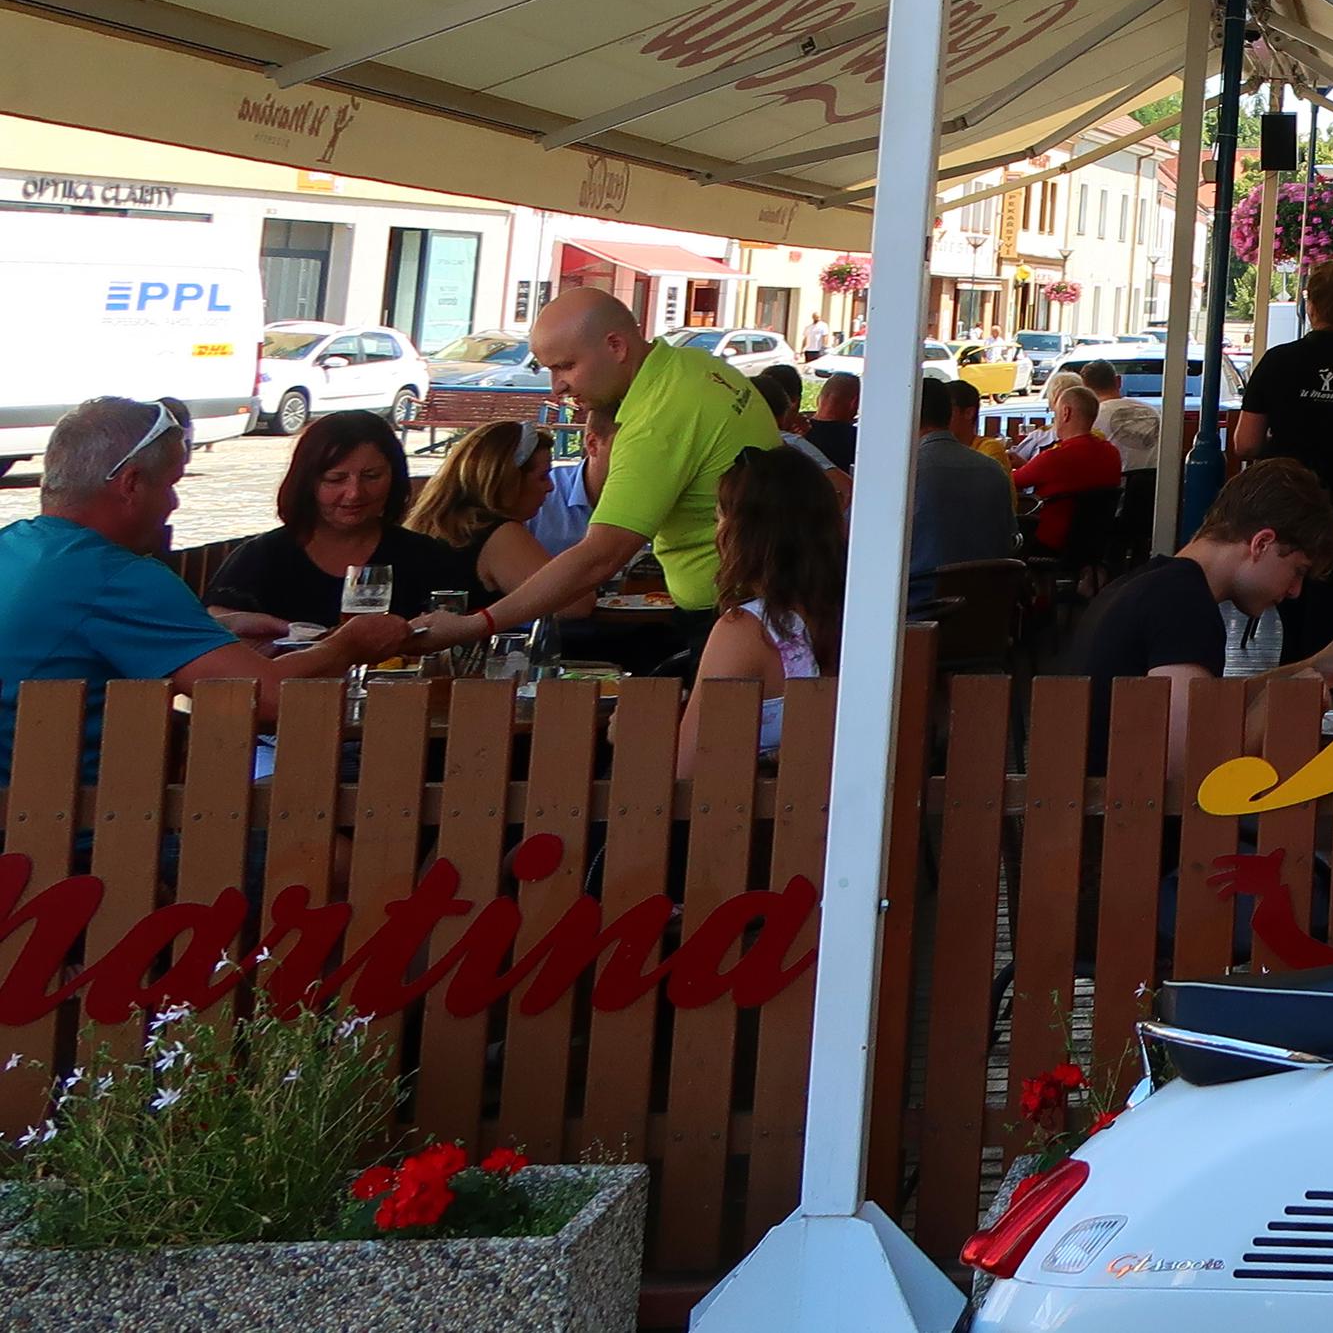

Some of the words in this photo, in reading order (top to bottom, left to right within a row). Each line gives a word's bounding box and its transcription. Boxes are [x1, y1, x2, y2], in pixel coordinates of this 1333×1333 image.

[22, 175, 95, 201] OPTIKA
[101, 182, 177, 206] CLARITY
[137, 282, 231, 312] PPL
